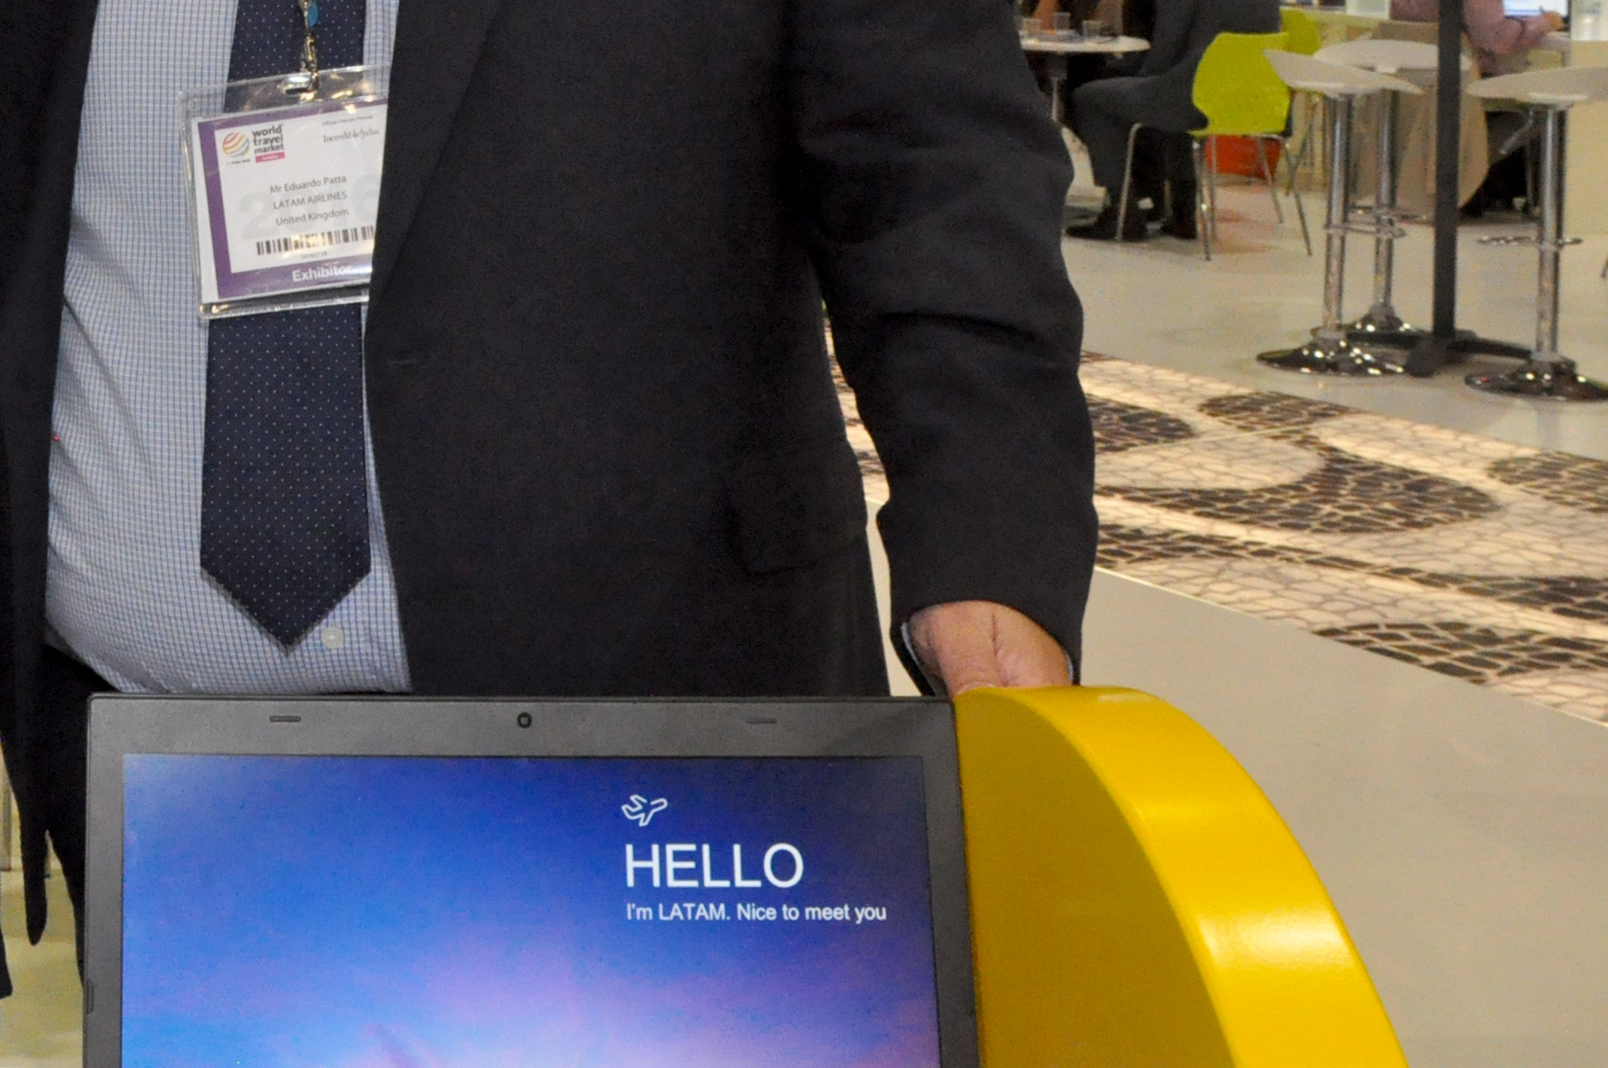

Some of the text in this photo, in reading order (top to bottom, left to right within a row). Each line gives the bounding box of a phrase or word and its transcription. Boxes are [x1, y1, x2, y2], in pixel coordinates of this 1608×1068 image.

[252, 124, 282, 137] world
[253, 134, 283, 146] travel
[254, 143, 284, 154] market
[270, 185, 282, 194] Mr
[284, 179, 321, 192] Eduardo
[273, 191, 348, 210] LATAM AIRLINES
[275, 209, 349, 226] United Kingdom
[292, 264, 353, 282] Exhibitor
[625, 843, 804, 887] HELLO
[627, 903, 887, 924] I'm LATAM. Nice to meet you
